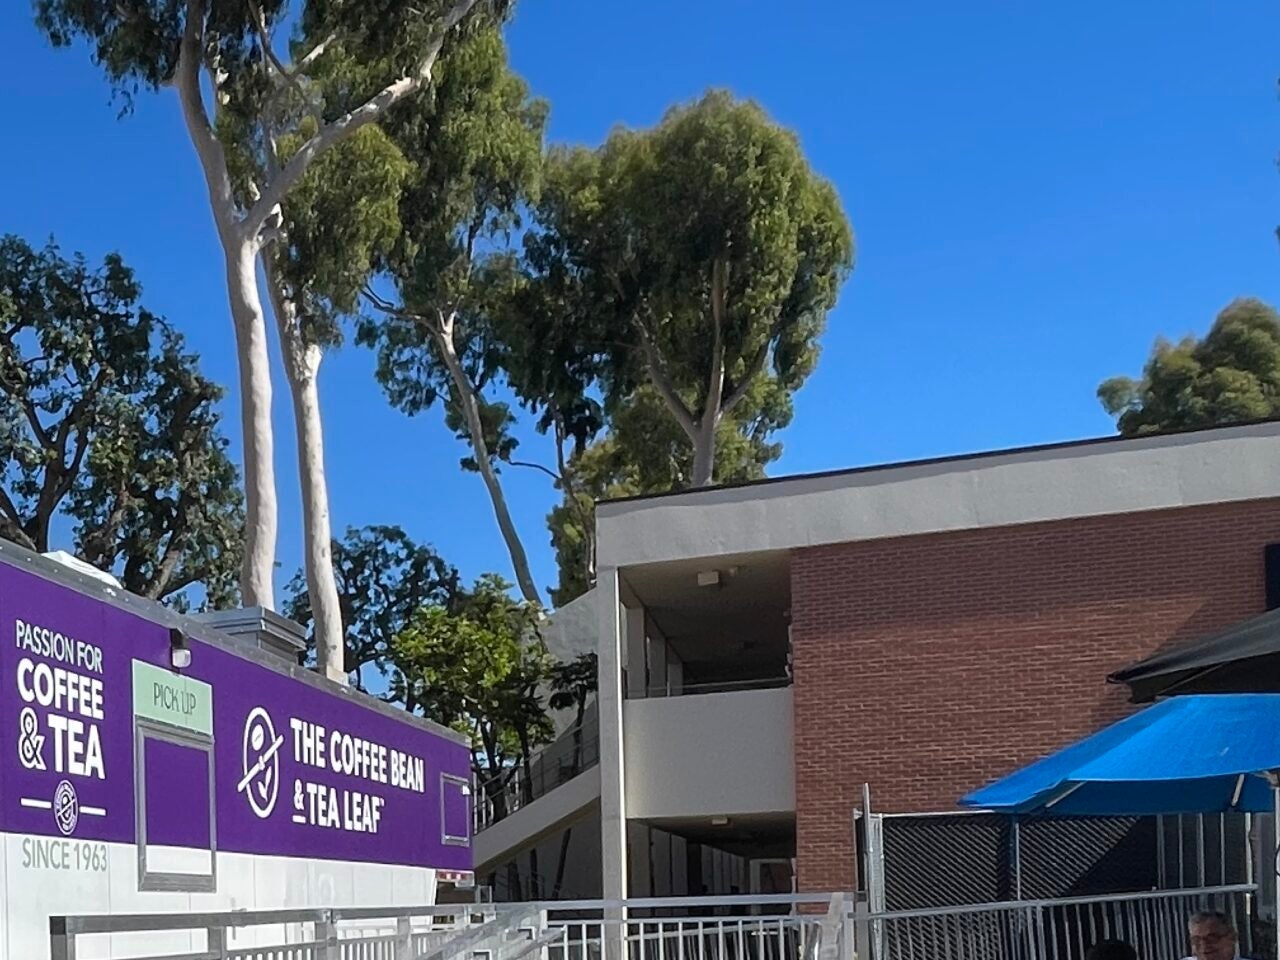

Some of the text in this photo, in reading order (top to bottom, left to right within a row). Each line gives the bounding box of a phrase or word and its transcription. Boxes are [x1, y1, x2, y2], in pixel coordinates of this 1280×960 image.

[15, 619, 103, 674] PASSION FOR
[17, 657, 104, 720] COFFEE
[153, 682, 197, 716] PICK UP
[18, 706, 106, 780] & TEA
[290, 717, 425, 793] THE COFFEE BEAN
[293, 778, 381, 833] & TEA LEAF
[22, 838, 108, 872] SINCE 1963
